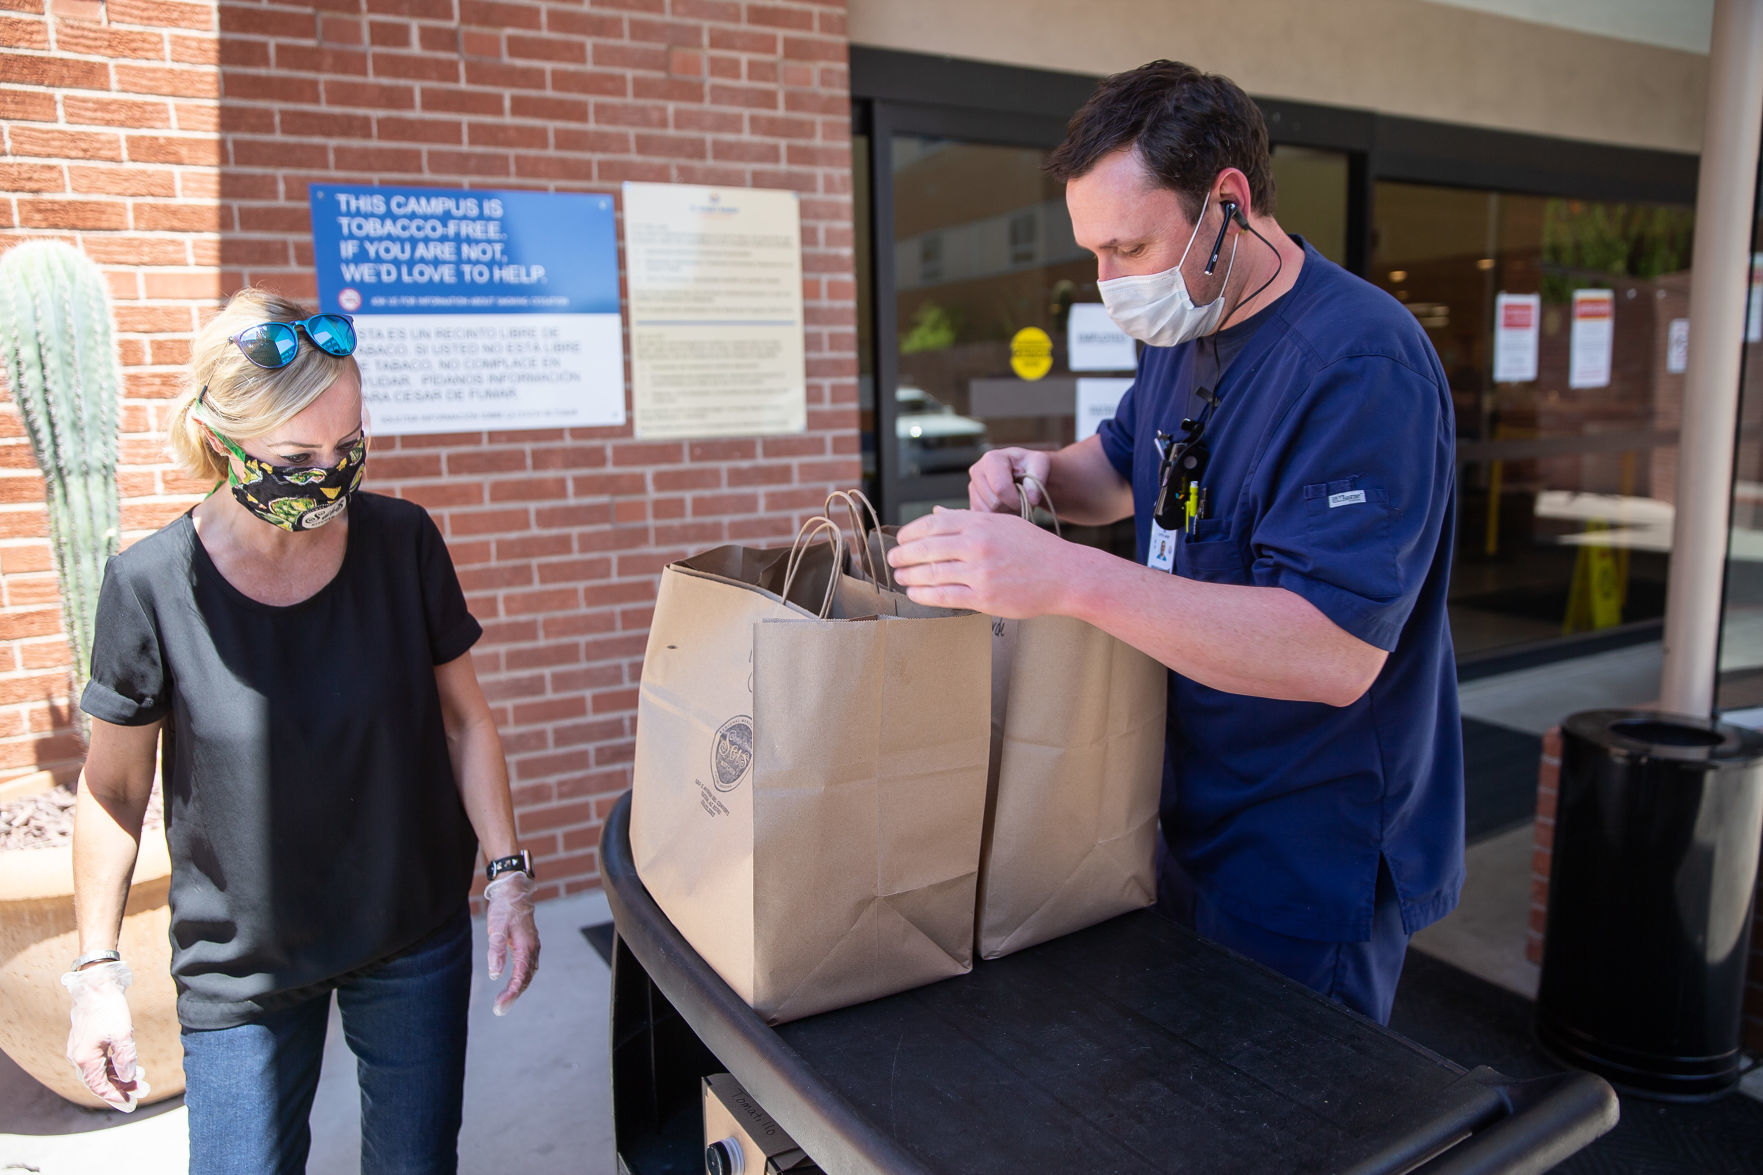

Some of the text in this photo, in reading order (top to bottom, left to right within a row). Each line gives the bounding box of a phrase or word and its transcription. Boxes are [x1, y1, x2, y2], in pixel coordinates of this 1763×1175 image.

[335, 193, 504, 218] THIS CAMPUS IS
[337, 216, 508, 240] TOBACCO-FREE.
[340, 240, 360, 260] IF
[363, 240, 411, 260] YOU
[414, 241, 458, 261] ARE
[341, 262, 548, 285] WE'D LOVE TO HELP.
[357, 328, 385, 339] STA
[731, 1086, 776, 1136] Tomatillo
